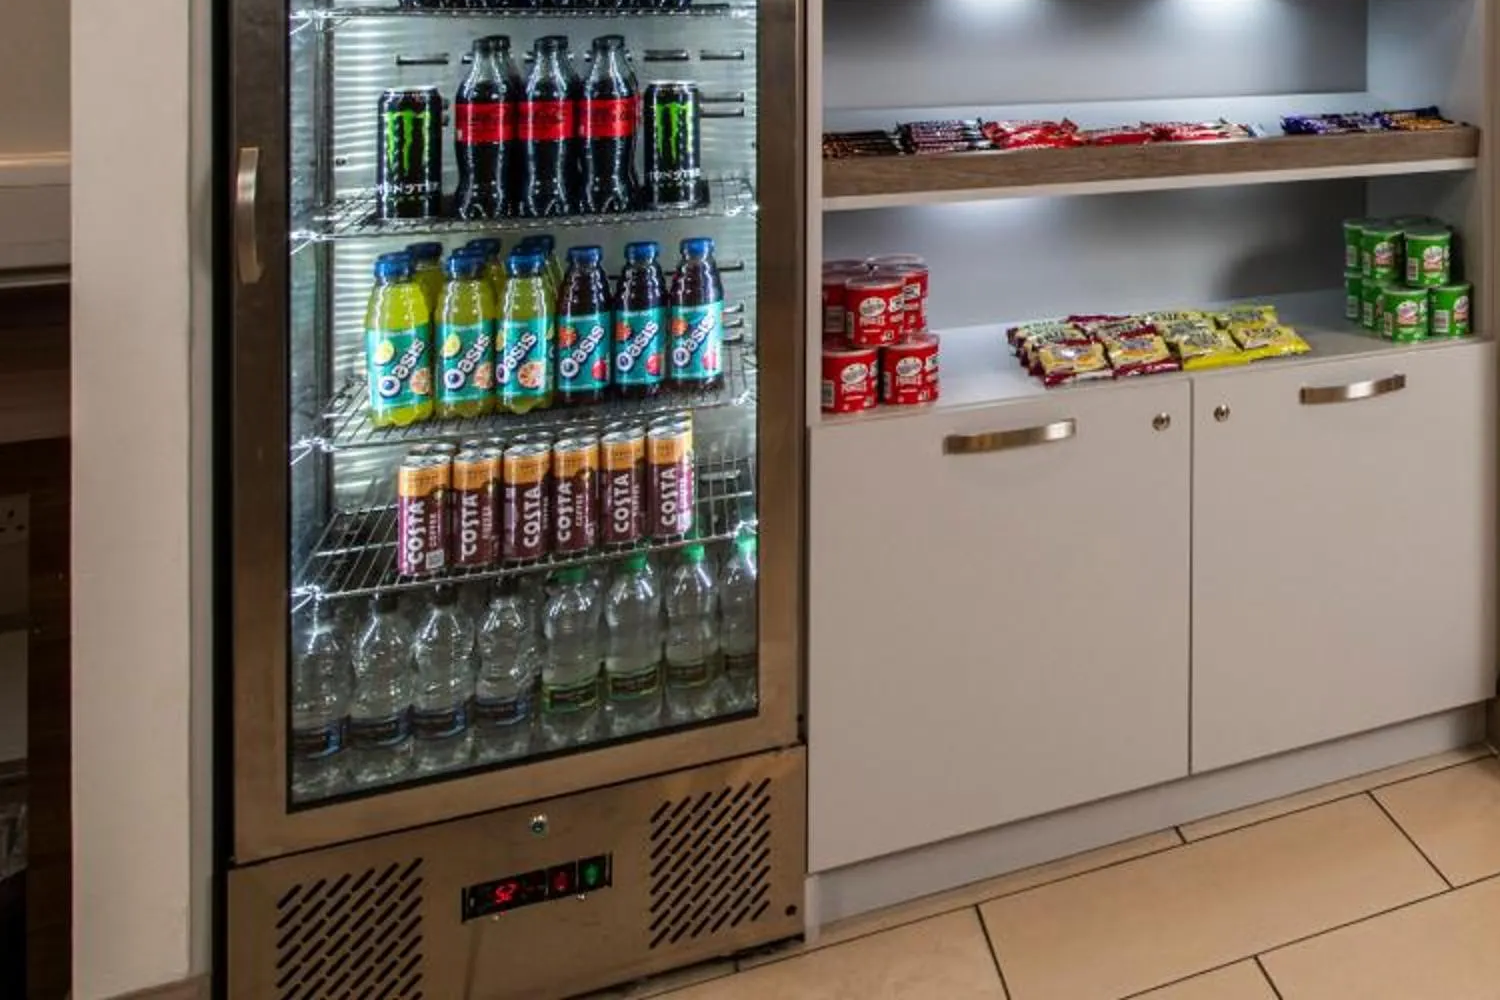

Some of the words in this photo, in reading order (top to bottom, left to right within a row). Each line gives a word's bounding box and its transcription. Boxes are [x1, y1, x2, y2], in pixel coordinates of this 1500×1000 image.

[378, 338, 424, 397] Oasis
[443, 333, 490, 390] Oasis
[496, 332, 537, 384] Oasis
[560, 325, 604, 378] Oasis
[616, 320, 659, 372] Oasis
[673, 310, 715, 366] Oasis
[461, 493, 479, 556] COSTA
[523, 486, 542, 548] COSTA
[557, 481, 574, 541] COSTA
[613, 473, 631, 534] COSTA
[660, 467, 678, 526] COSTA
[407, 500, 427, 565] COSTA
